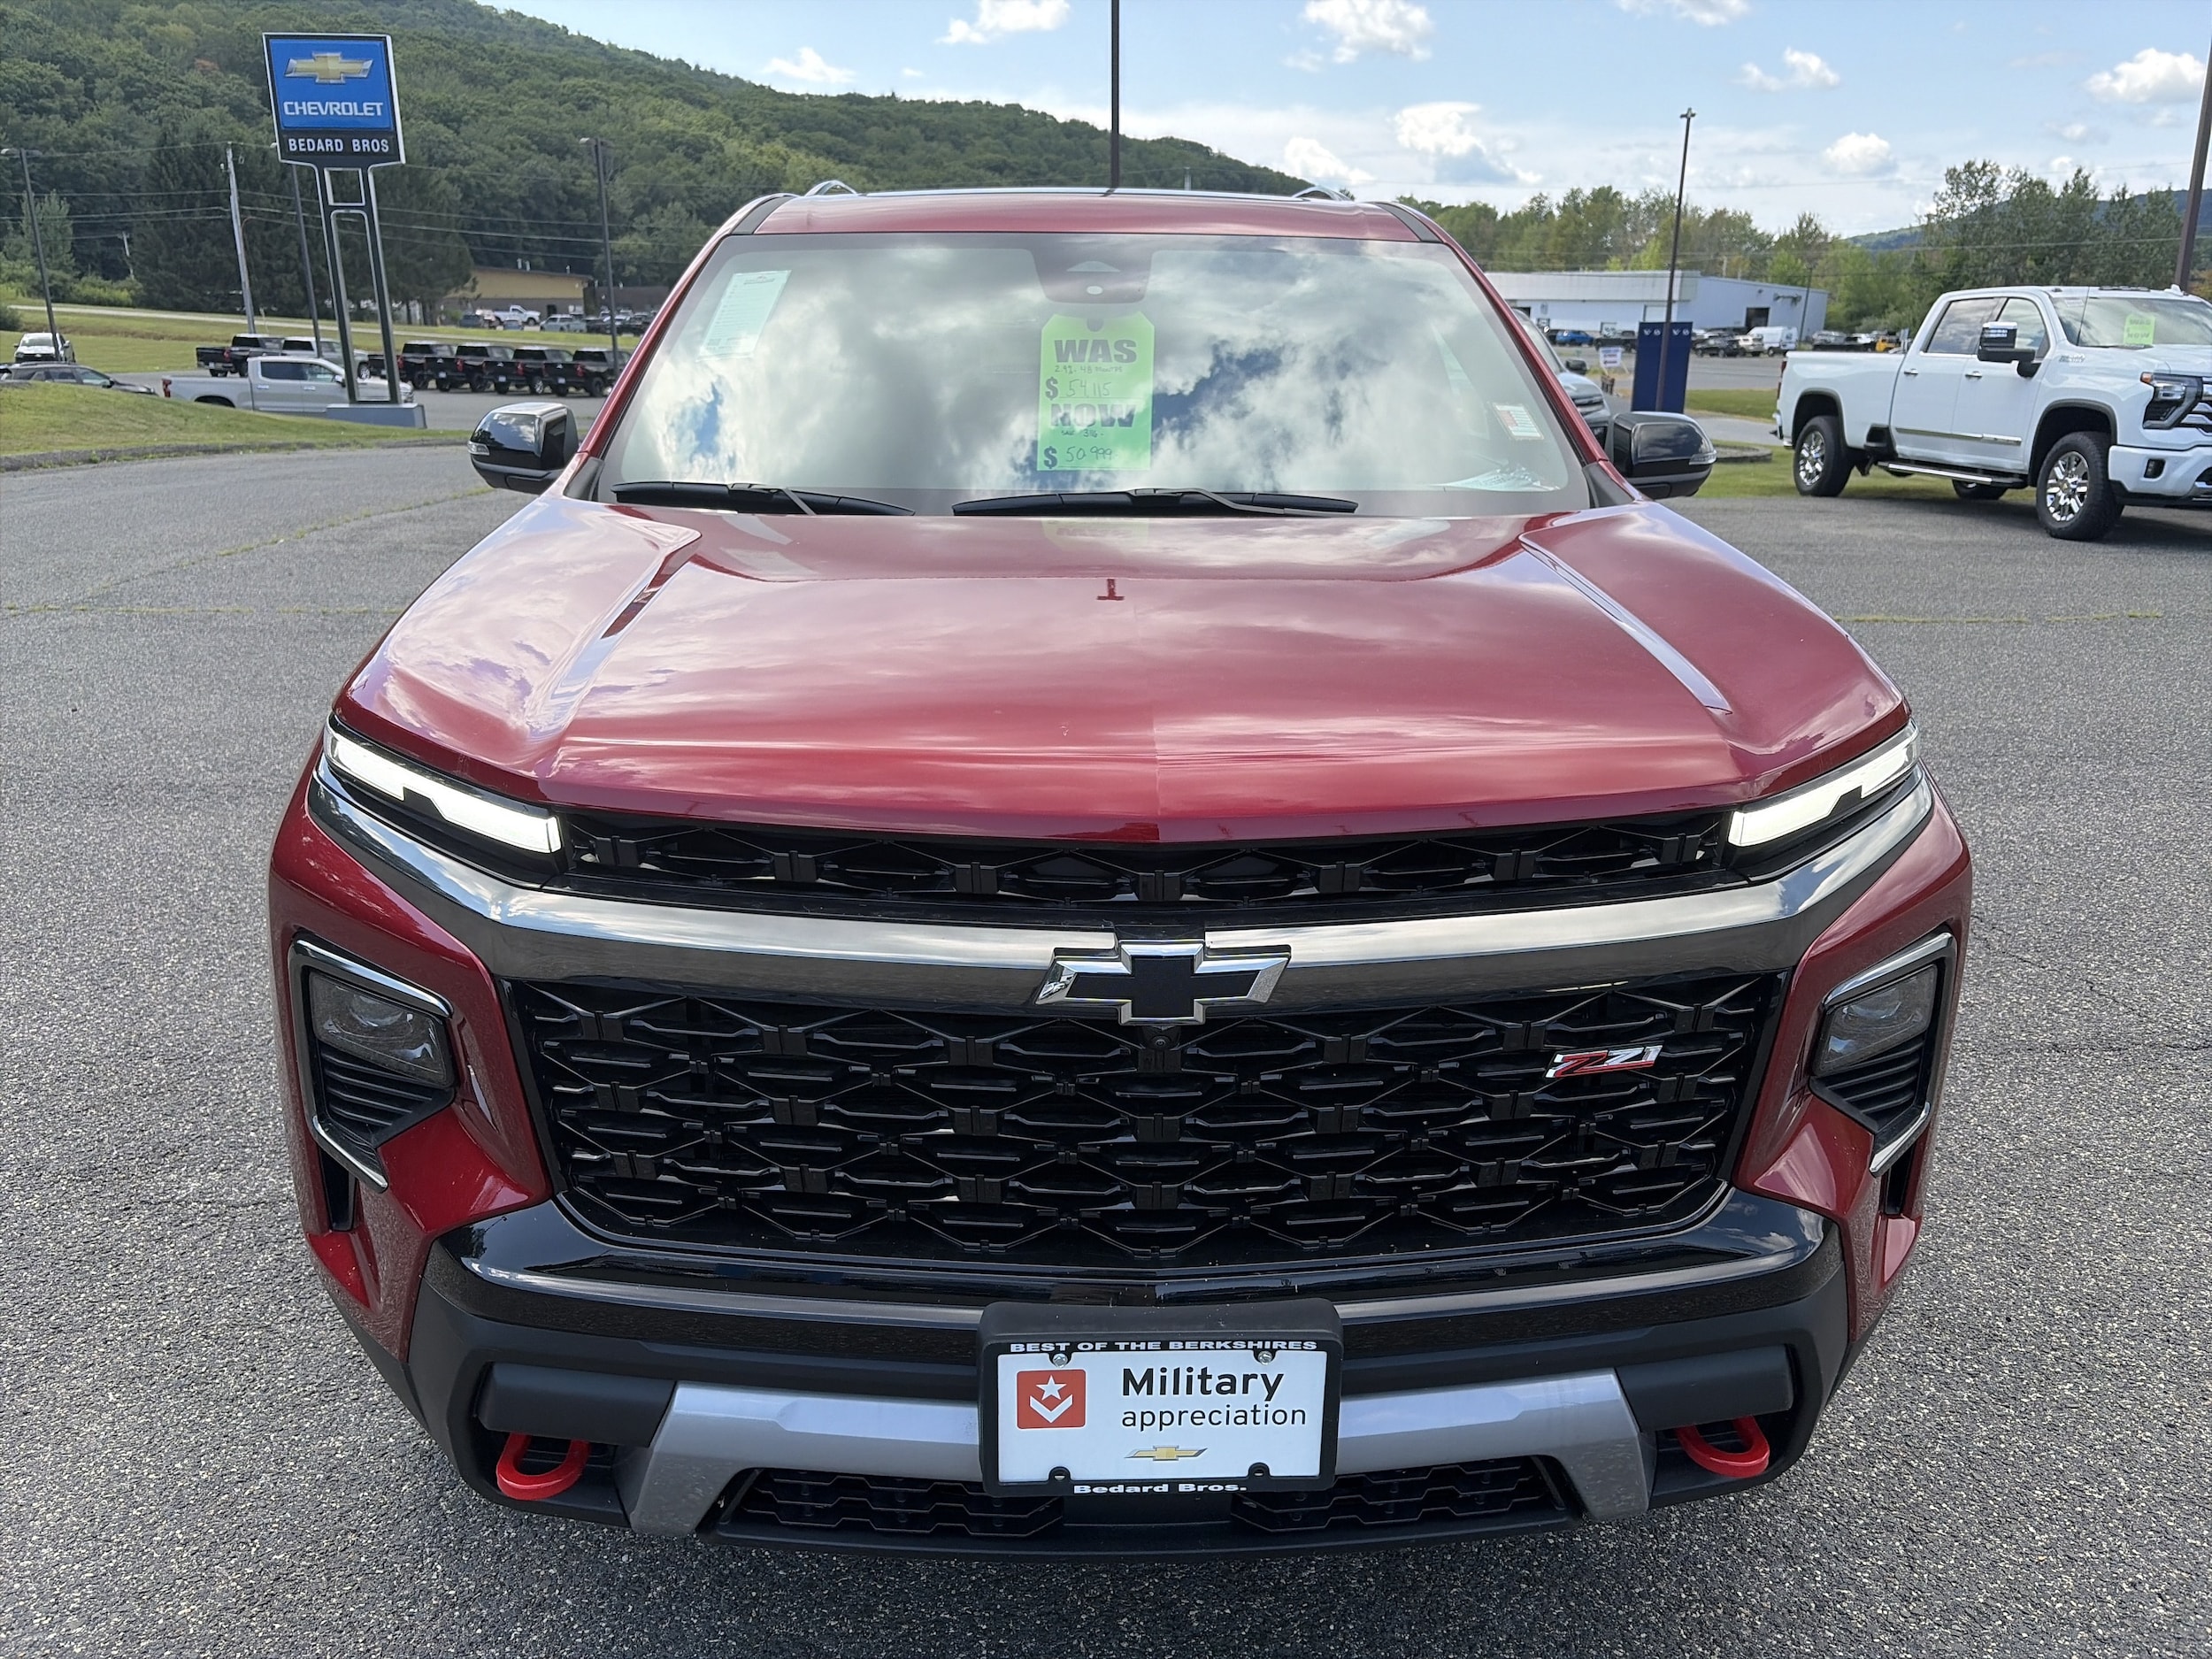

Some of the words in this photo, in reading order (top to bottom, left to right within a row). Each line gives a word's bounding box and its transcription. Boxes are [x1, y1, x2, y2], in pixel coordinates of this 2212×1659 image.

[283, 102, 383, 116] CHEVROLET
[288, 138, 344, 152] BEDARD
[351, 139, 389, 153] BROS
[1054, 340, 1137, 363] WAS
[1046, 377, 1058, 400] $
[1050, 403, 1136, 427] NOW
[1044, 446, 1057, 469] $
[1545, 1045, 1663, 1078] Z71
[1010, 1342, 1071, 1353] BEST
[1077, 1342, 1108, 1351] OF
[1115, 1341, 1162, 1350] THE
[1168, 1340, 1317, 1350] BERKSHIRES
[1122, 1366, 1284, 1402] Military
[1121, 1403, 1306, 1432] appreciation
[1073, 1484, 1169, 1494] Bedard
[1179, 1483, 1247, 1493] Bros.
